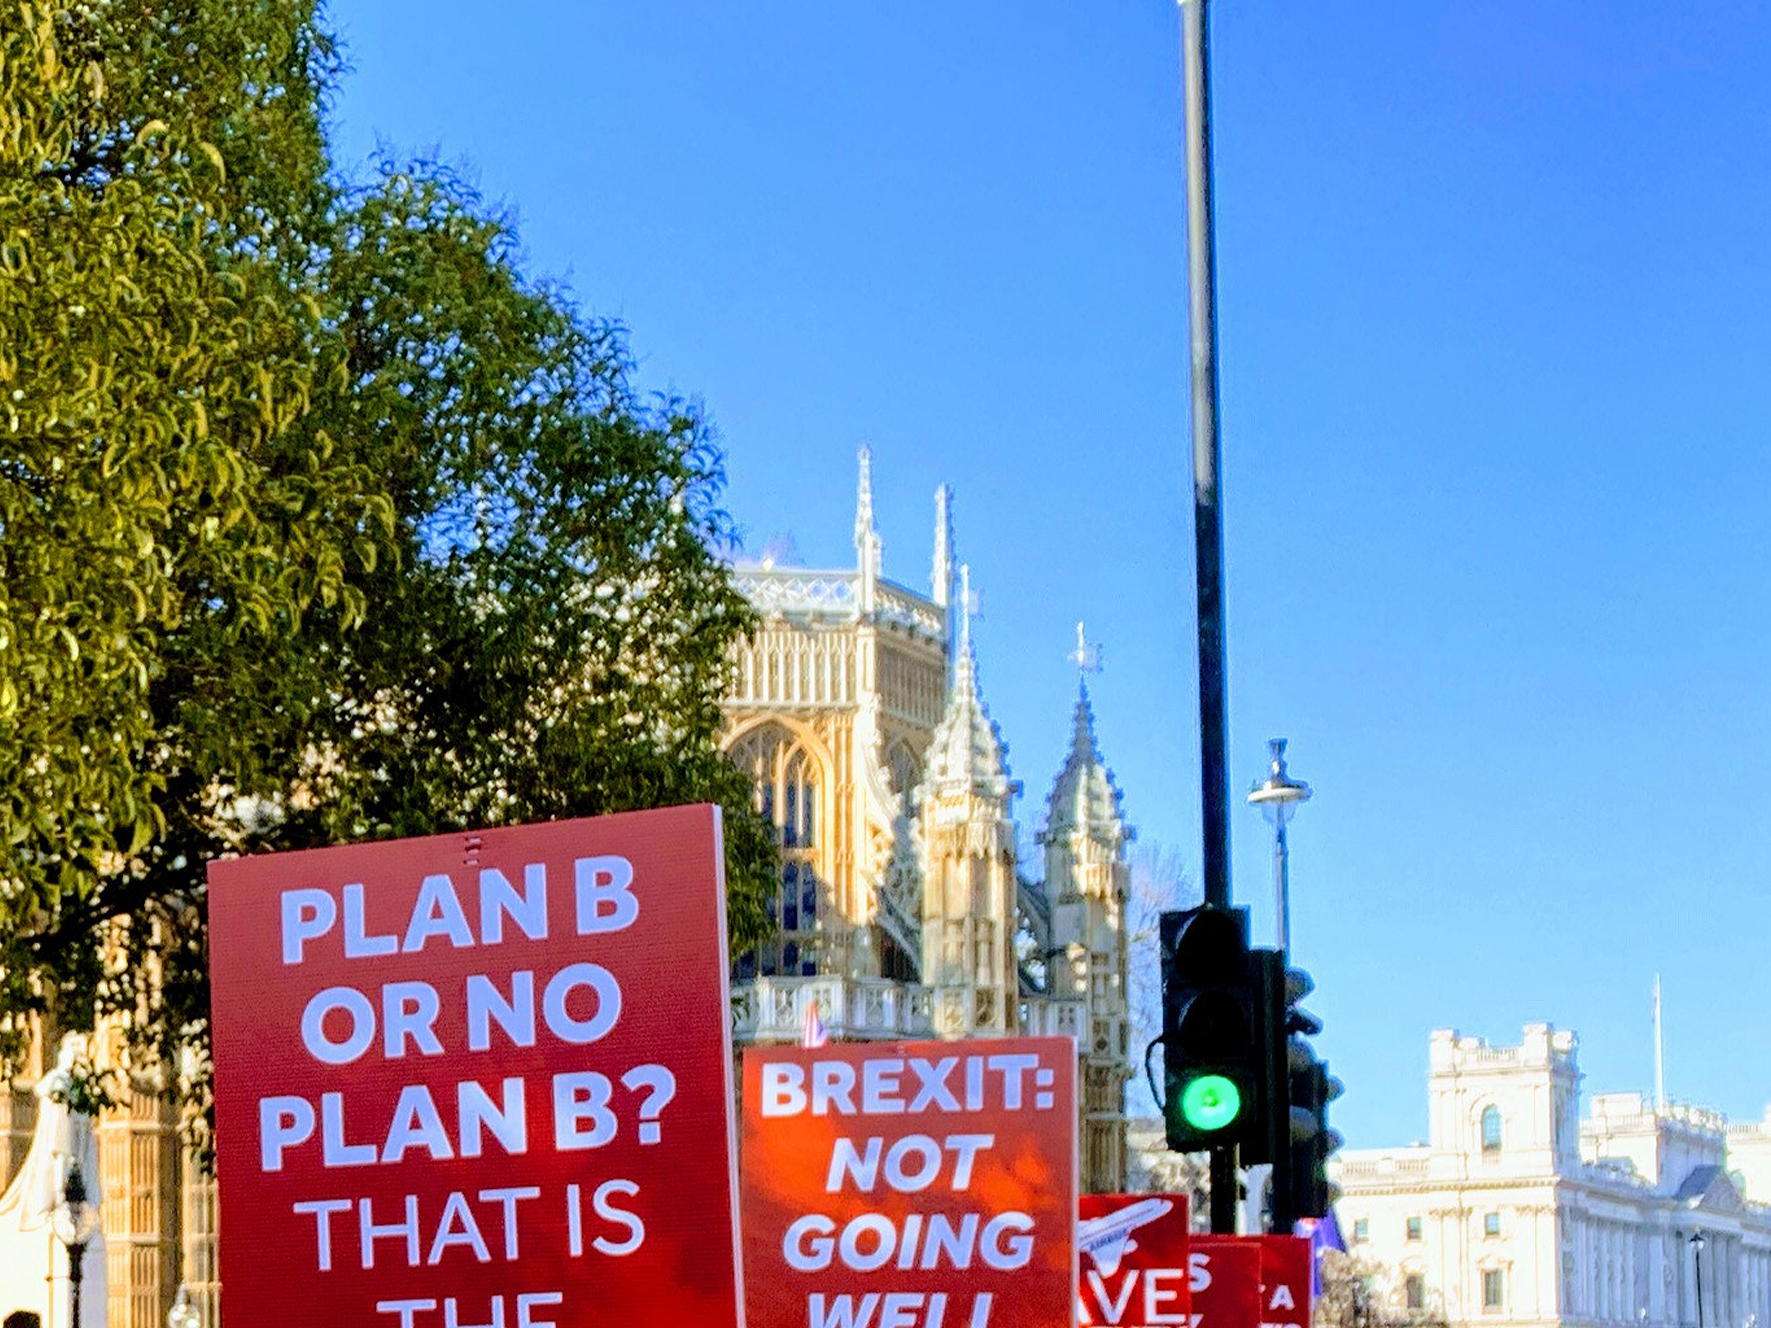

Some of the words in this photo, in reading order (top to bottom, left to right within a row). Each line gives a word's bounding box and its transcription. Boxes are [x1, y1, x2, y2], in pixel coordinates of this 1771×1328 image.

[281, 861, 548, 965] PLAN
[574, 855, 640, 935] B
[301, 981, 445, 1065] OR
[466, 963, 622, 1051] NO
[259, 1077, 528, 1171] PLAN
[552, 1064, 676, 1151] B?
[760, 1053, 1054, 1118] BREXIT:
[825, 1133, 995, 1193] NOT
[293, 1186, 541, 1271] THAT
[567, 1179, 645, 1257] IS
[783, 1211, 1035, 1271] GOING
